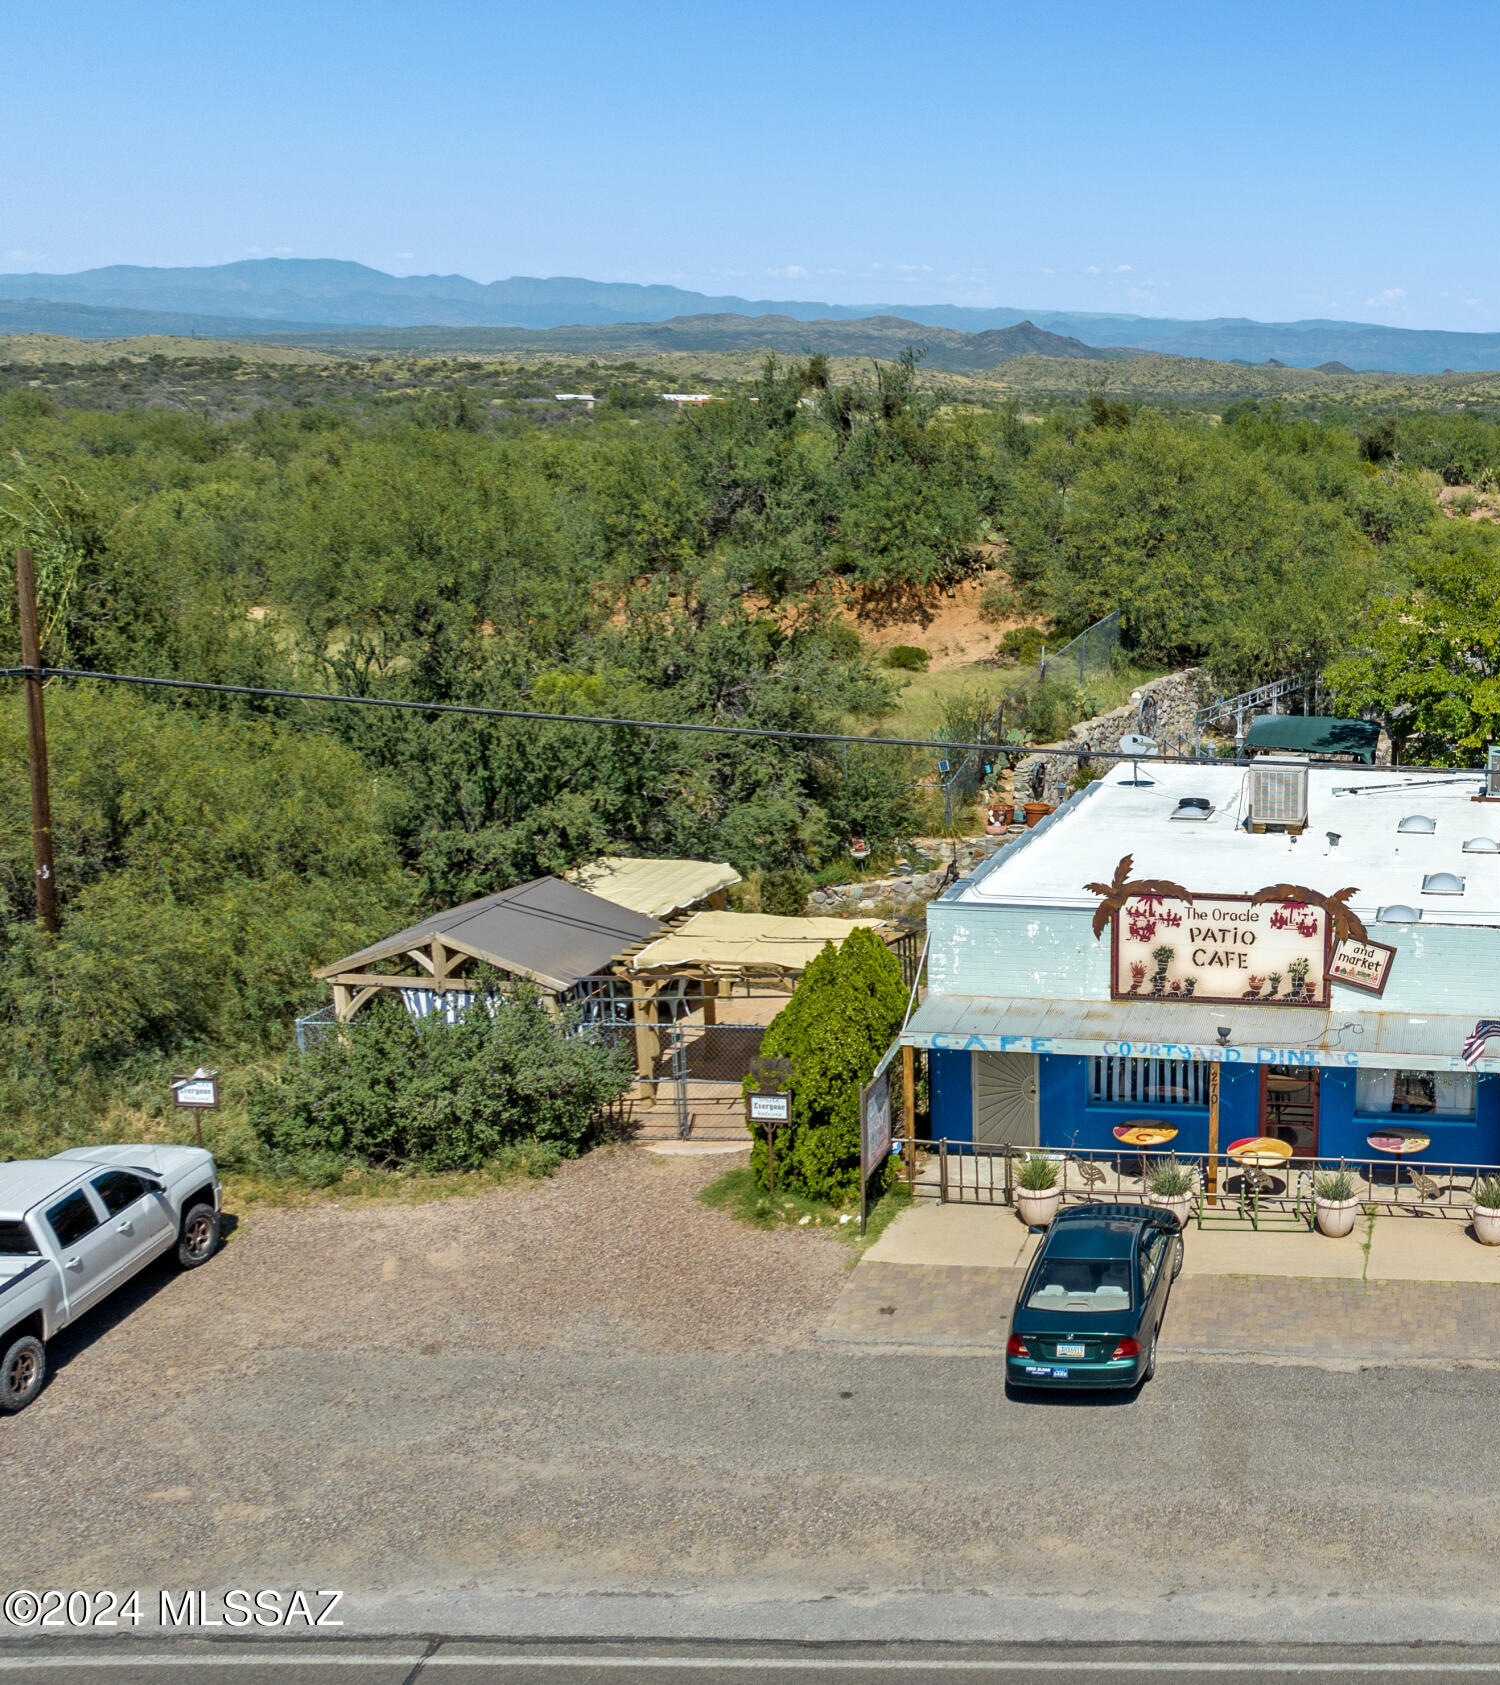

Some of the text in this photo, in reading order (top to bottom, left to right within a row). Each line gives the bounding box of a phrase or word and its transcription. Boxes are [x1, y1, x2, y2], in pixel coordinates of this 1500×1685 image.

[1185, 906, 1260, 922] The Oracle
[1192, 948, 1249, 969] CAFE
[1337, 951, 1383, 973] market
[1353, 945, 1375, 958] and
[1103, 1041, 1242, 1062] COURTYARD
